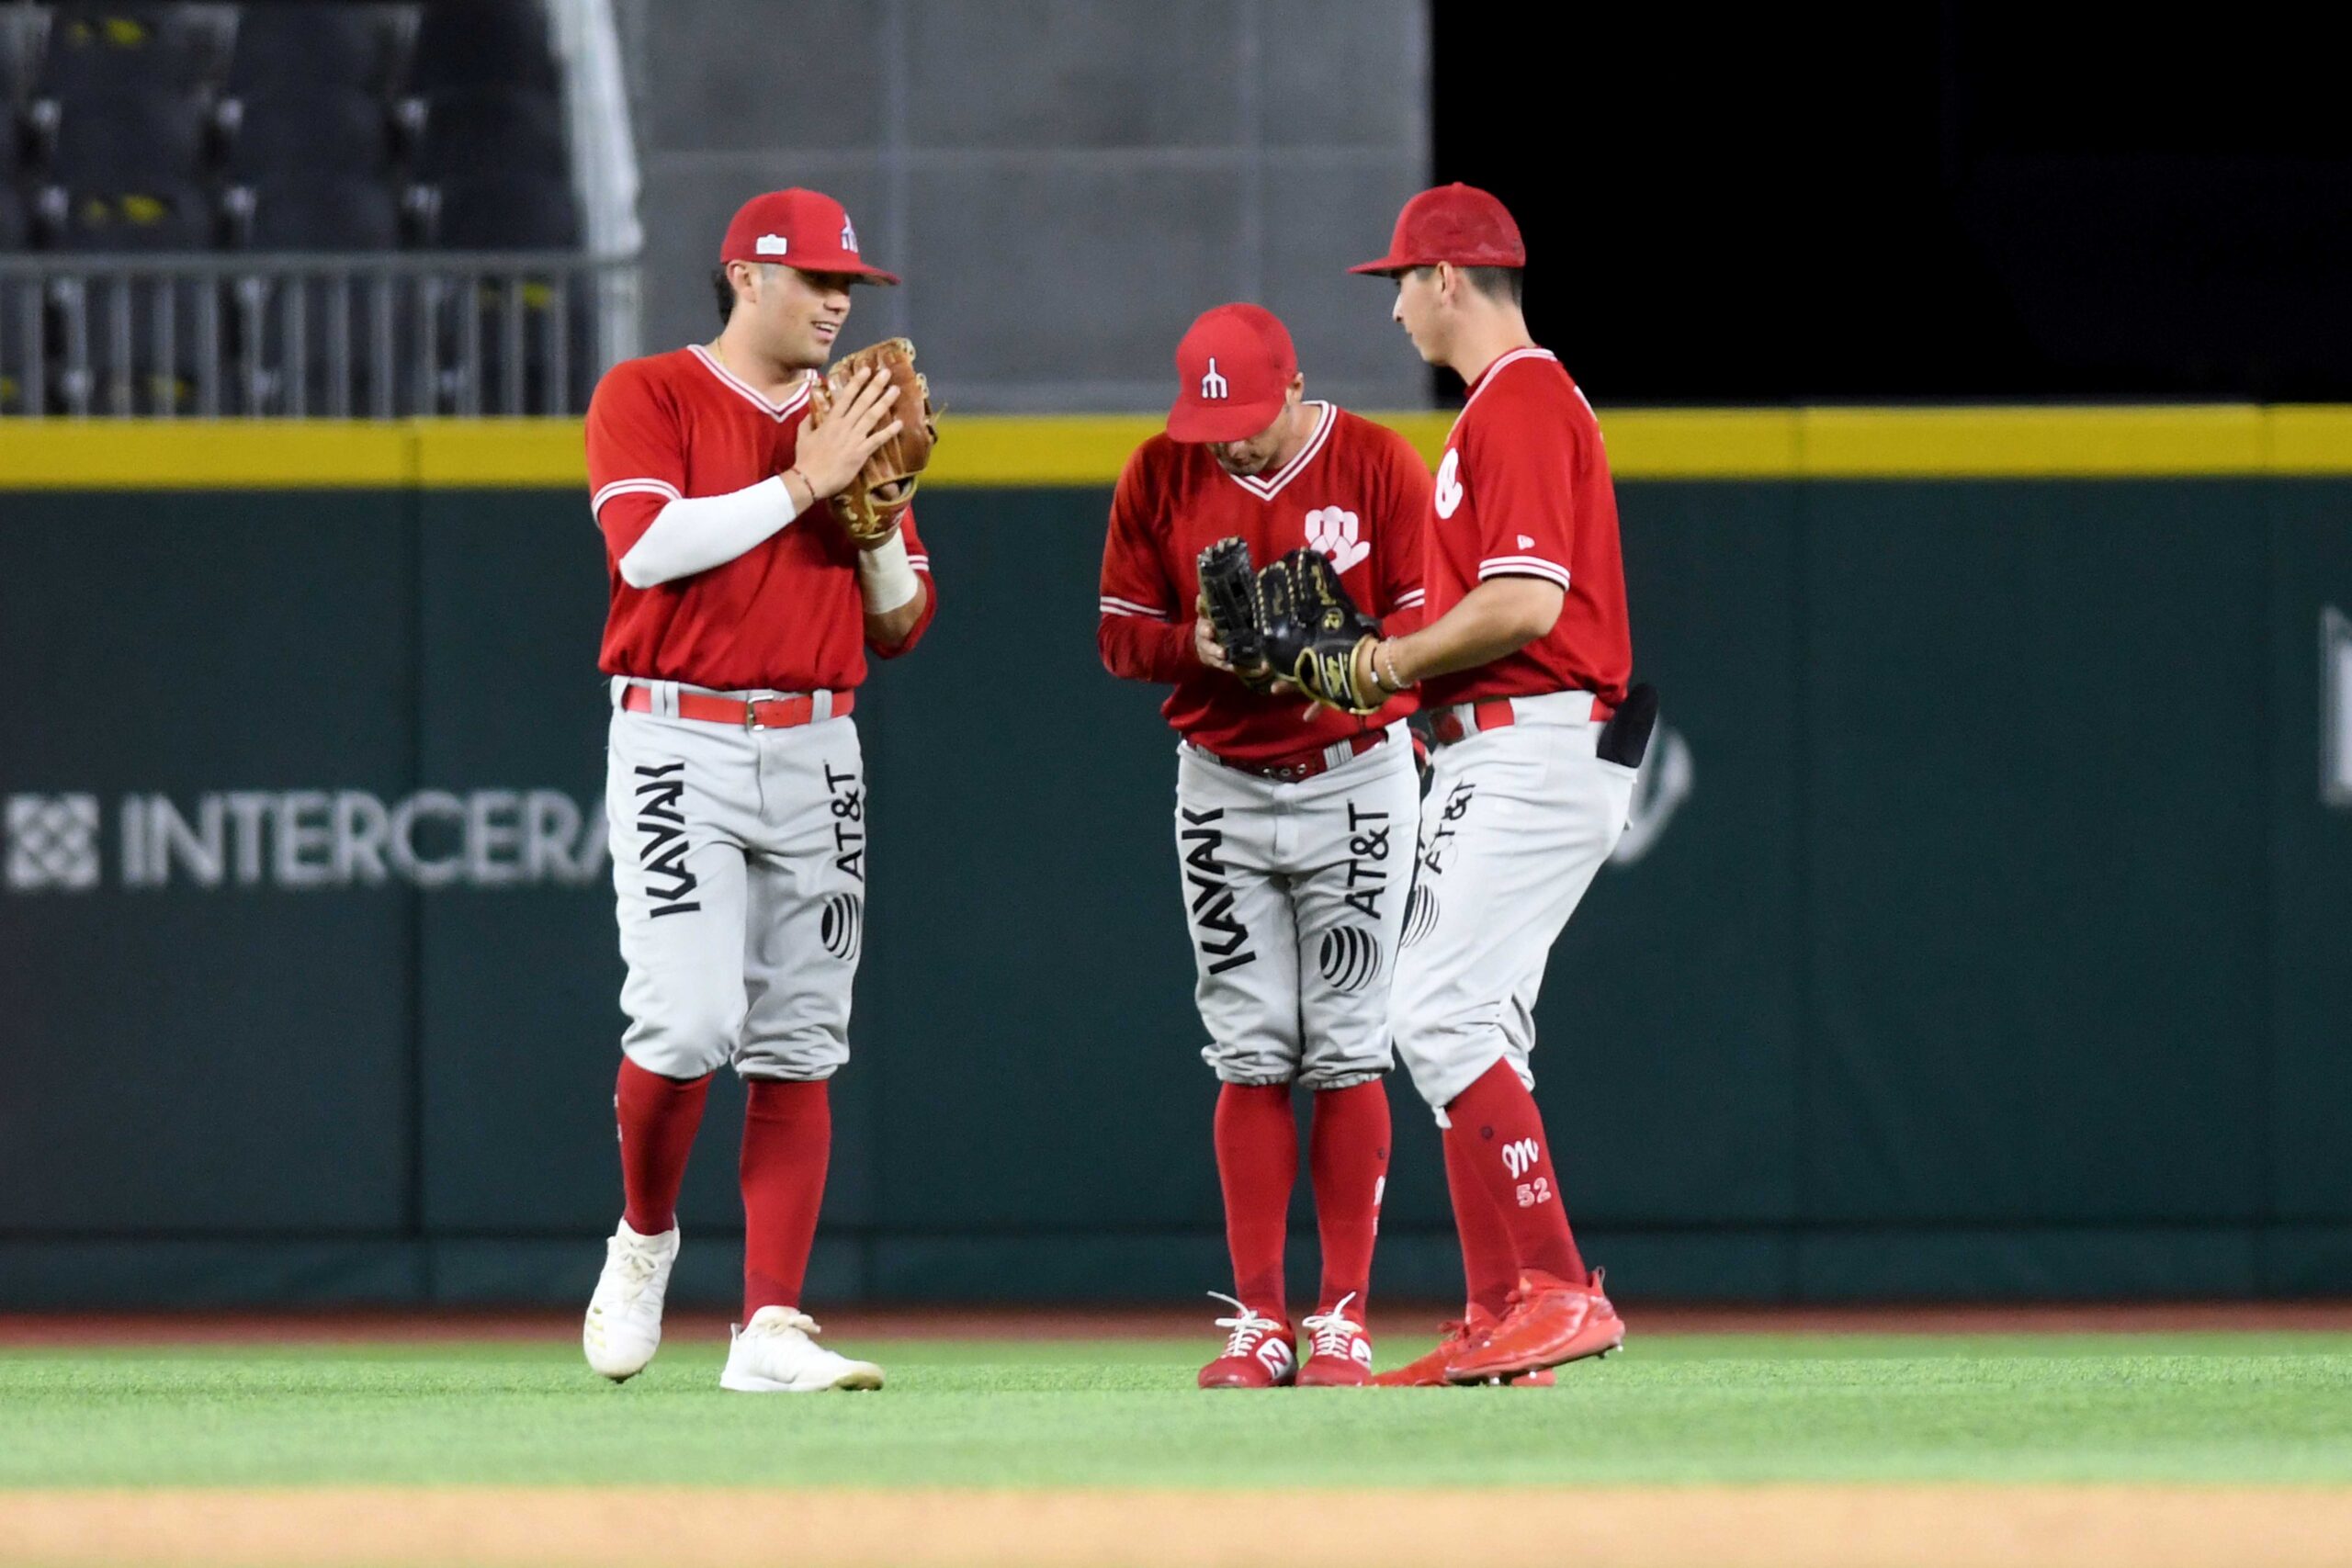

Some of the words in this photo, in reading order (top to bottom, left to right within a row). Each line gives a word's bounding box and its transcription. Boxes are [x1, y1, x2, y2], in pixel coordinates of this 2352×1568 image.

[634, 762, 701, 919] KAVAK
[825, 762, 863, 882] AT&T
[1345, 799, 1390, 919] AT&T
[1182, 807, 1257, 975] KAVAK
[1516, 1177, 1552, 1208] 52
